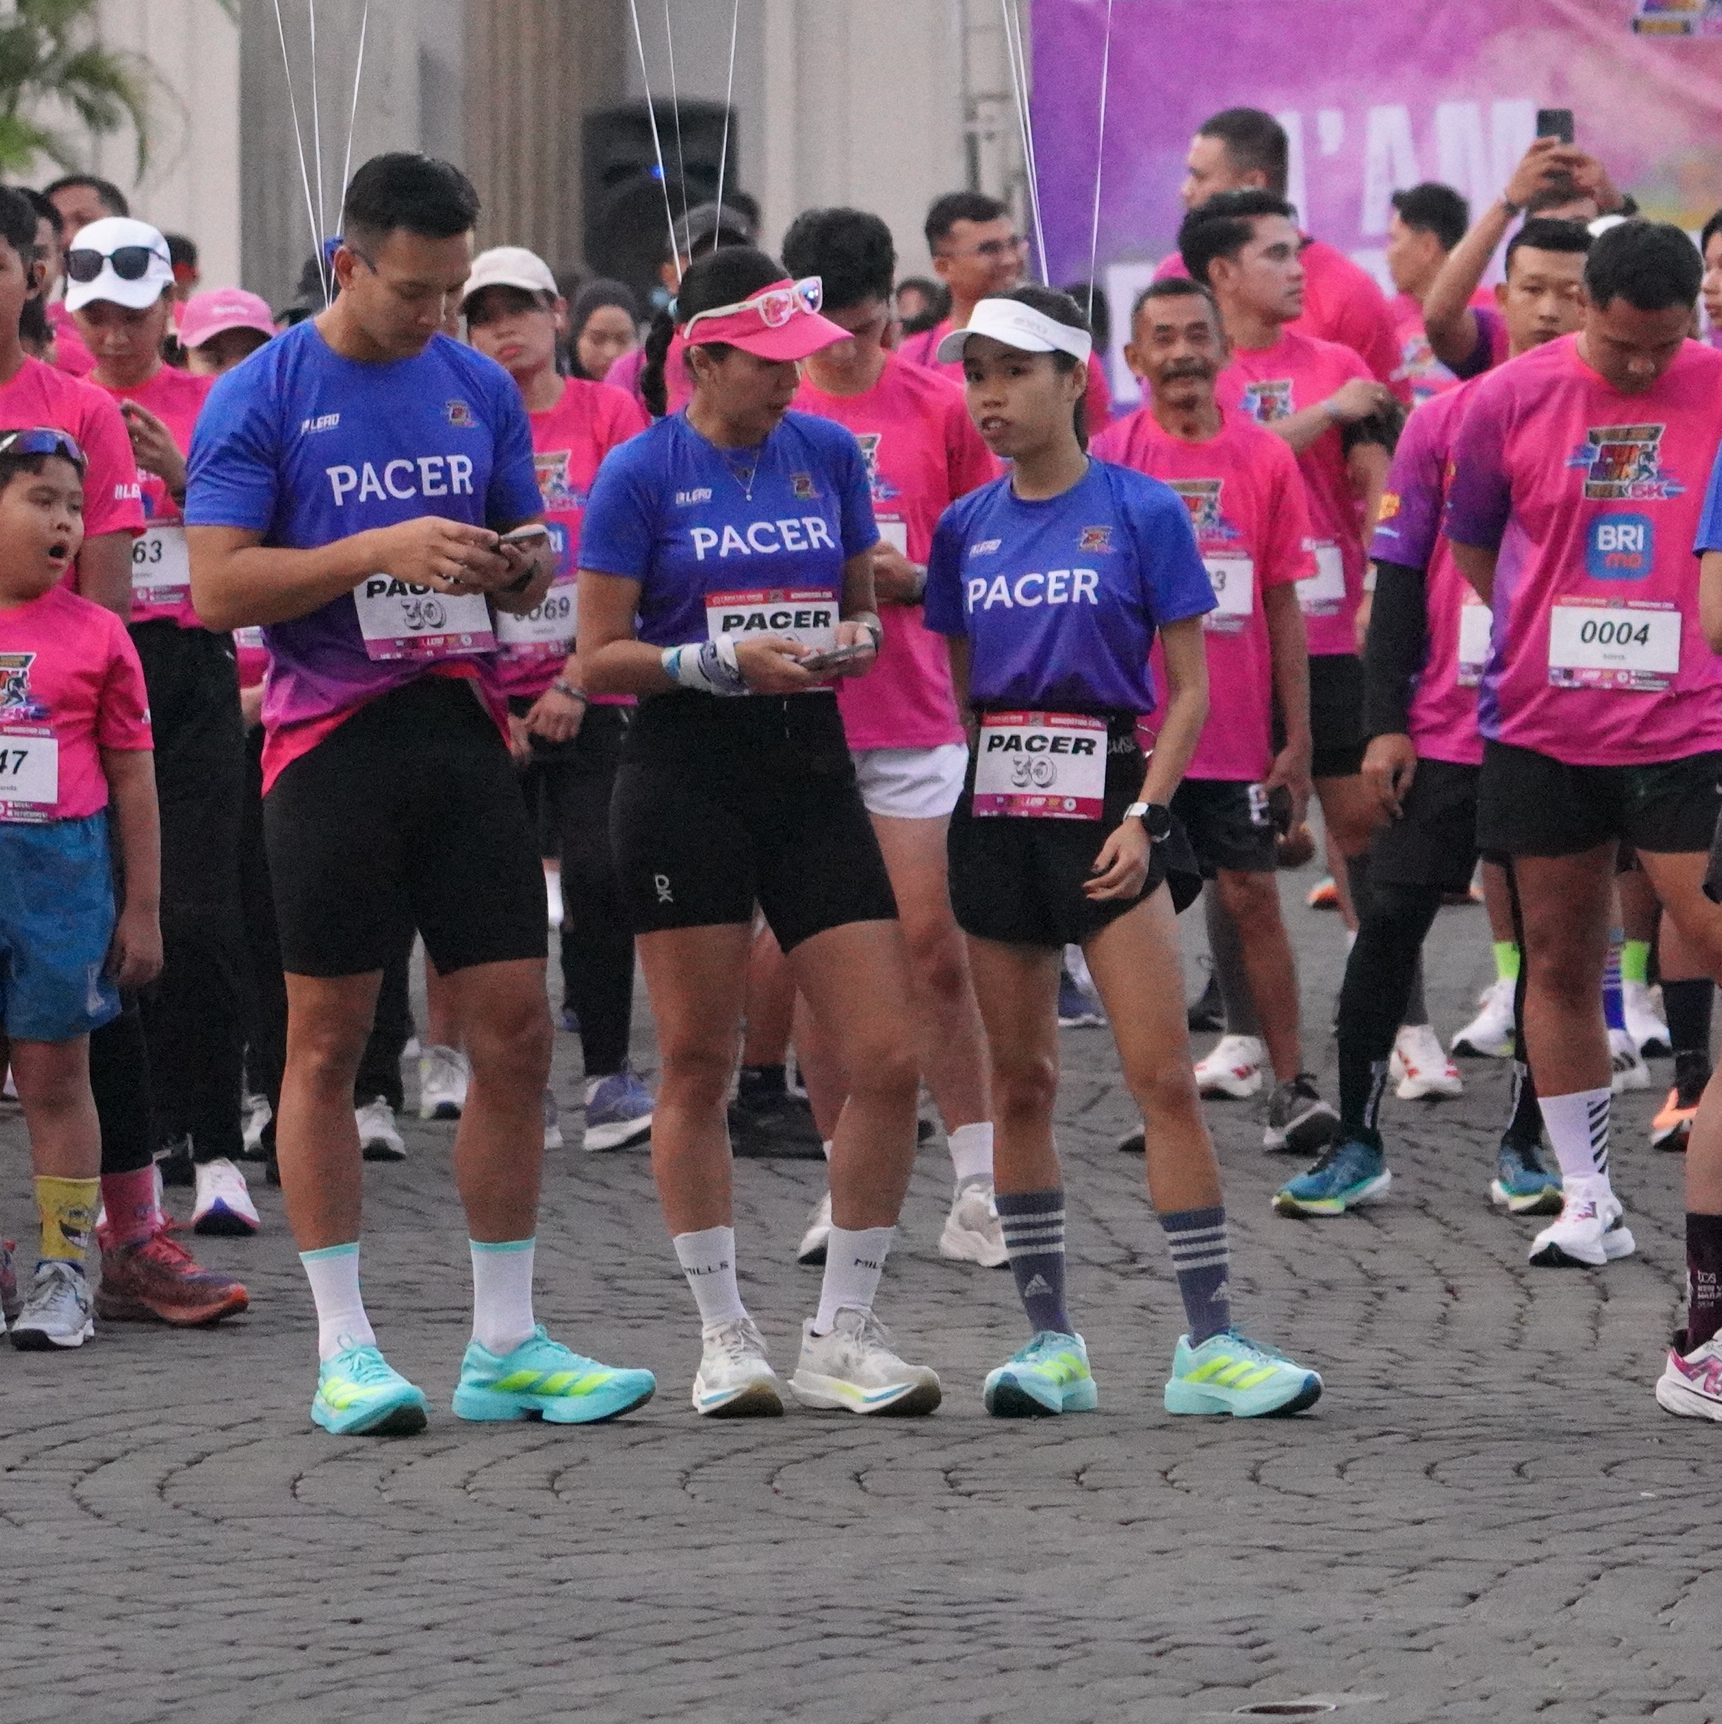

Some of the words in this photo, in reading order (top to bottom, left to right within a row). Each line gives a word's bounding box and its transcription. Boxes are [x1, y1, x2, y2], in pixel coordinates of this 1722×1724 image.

[326, 455, 474, 507] PACER
[690, 516, 836, 561] PACER
[1597, 524, 1644, 552] BRI
[967, 567, 1099, 614] PACER
[400, 597, 447, 630] 30
[721, 609, 832, 633] PACER
[1580, 619, 1651, 646] 0004
[986, 733, 1097, 756] PACER
[1011, 753, 1058, 789] 30
